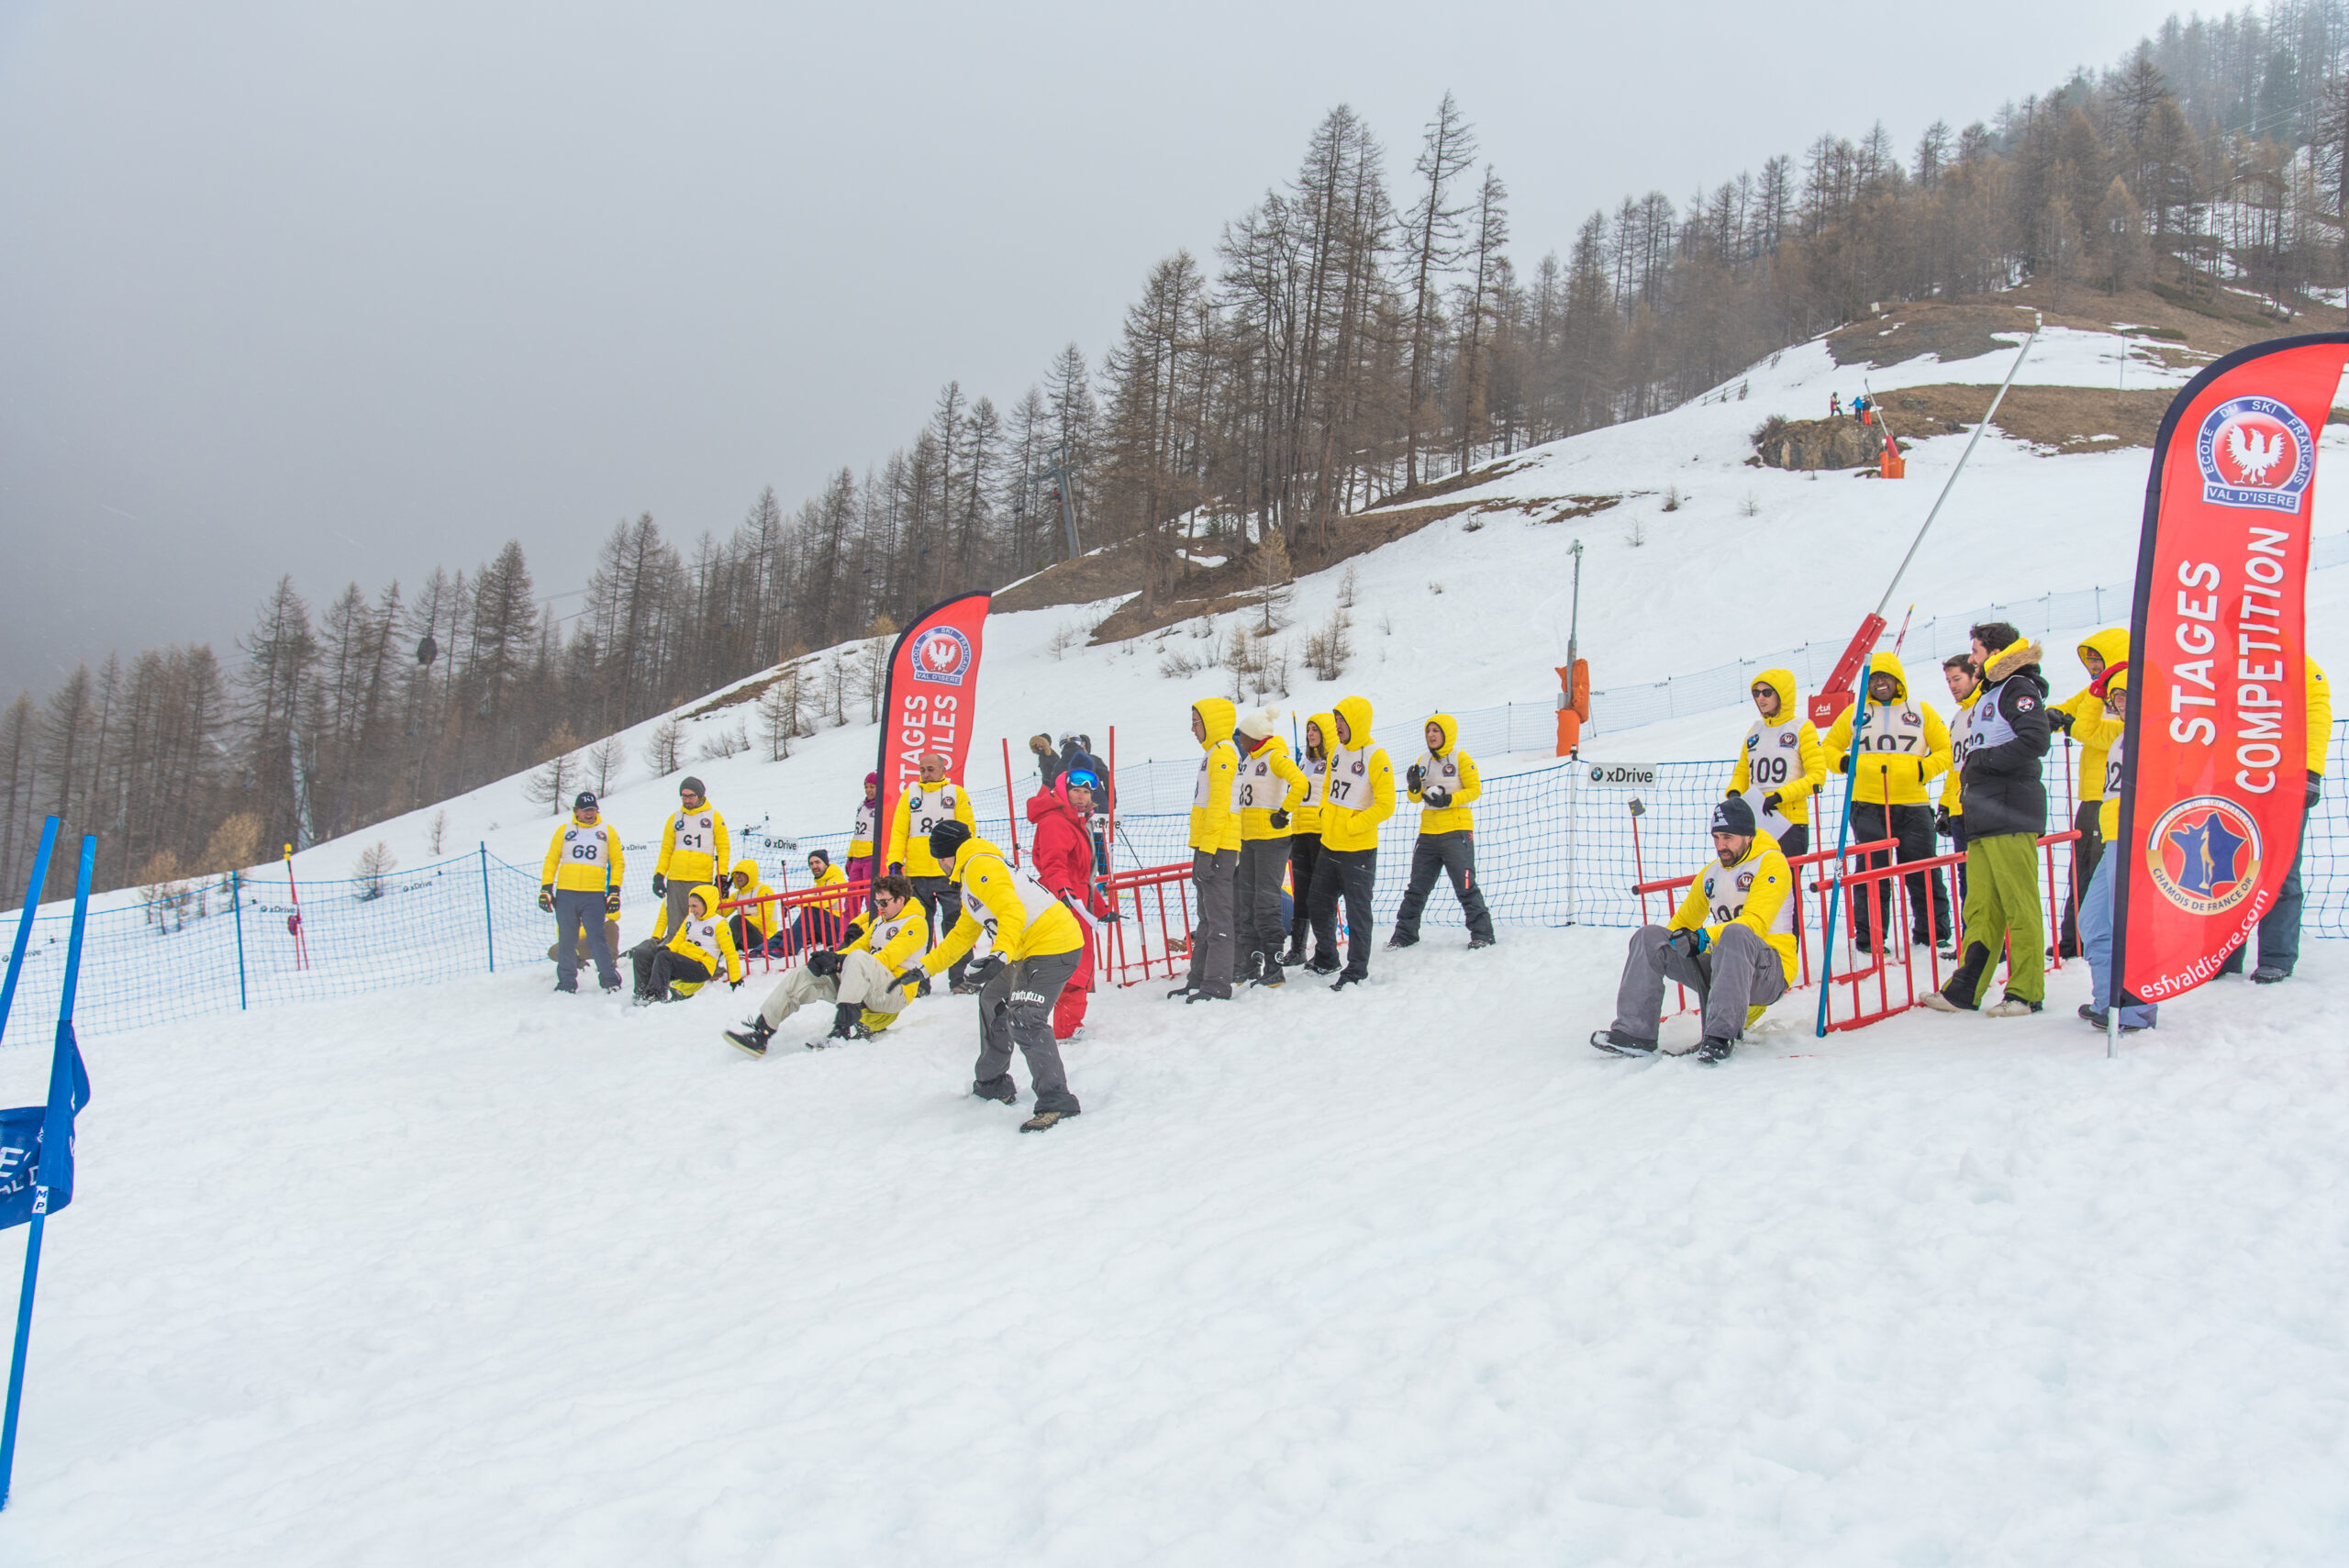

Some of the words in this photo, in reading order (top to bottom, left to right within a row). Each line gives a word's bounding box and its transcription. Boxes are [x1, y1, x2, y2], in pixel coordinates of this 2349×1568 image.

[2199, 427, 2215, 474] ECOLE
[2219, 404, 2239, 417] DU
[2252, 400, 2277, 414] SKI
[2209, 487, 2234, 501] VAL
[2239, 492, 2296, 507] D'ISERE
[2169, 560, 2221, 746] STAGES
[2235, 527, 2289, 794] COMPETITION
[1858, 734, 1918, 751] 107
[1607, 767, 1653, 783] xDrive
[1749, 757, 1787, 784] 109
[1239, 783, 1252, 806] 83
[1330, 779, 1352, 800] 87
[683, 834, 701, 848] 61
[773, 839, 797, 851] xDrive
[573, 845, 597, 860] 68
[2153, 868, 2189, 906] CHAMOIS
[2191, 901, 2205, 911] DE
[2207, 888, 2243, 911] FRANCE
[2240, 876, 2254, 893] OR
[2141, 889, 2269, 998] esfvaldisere.com
